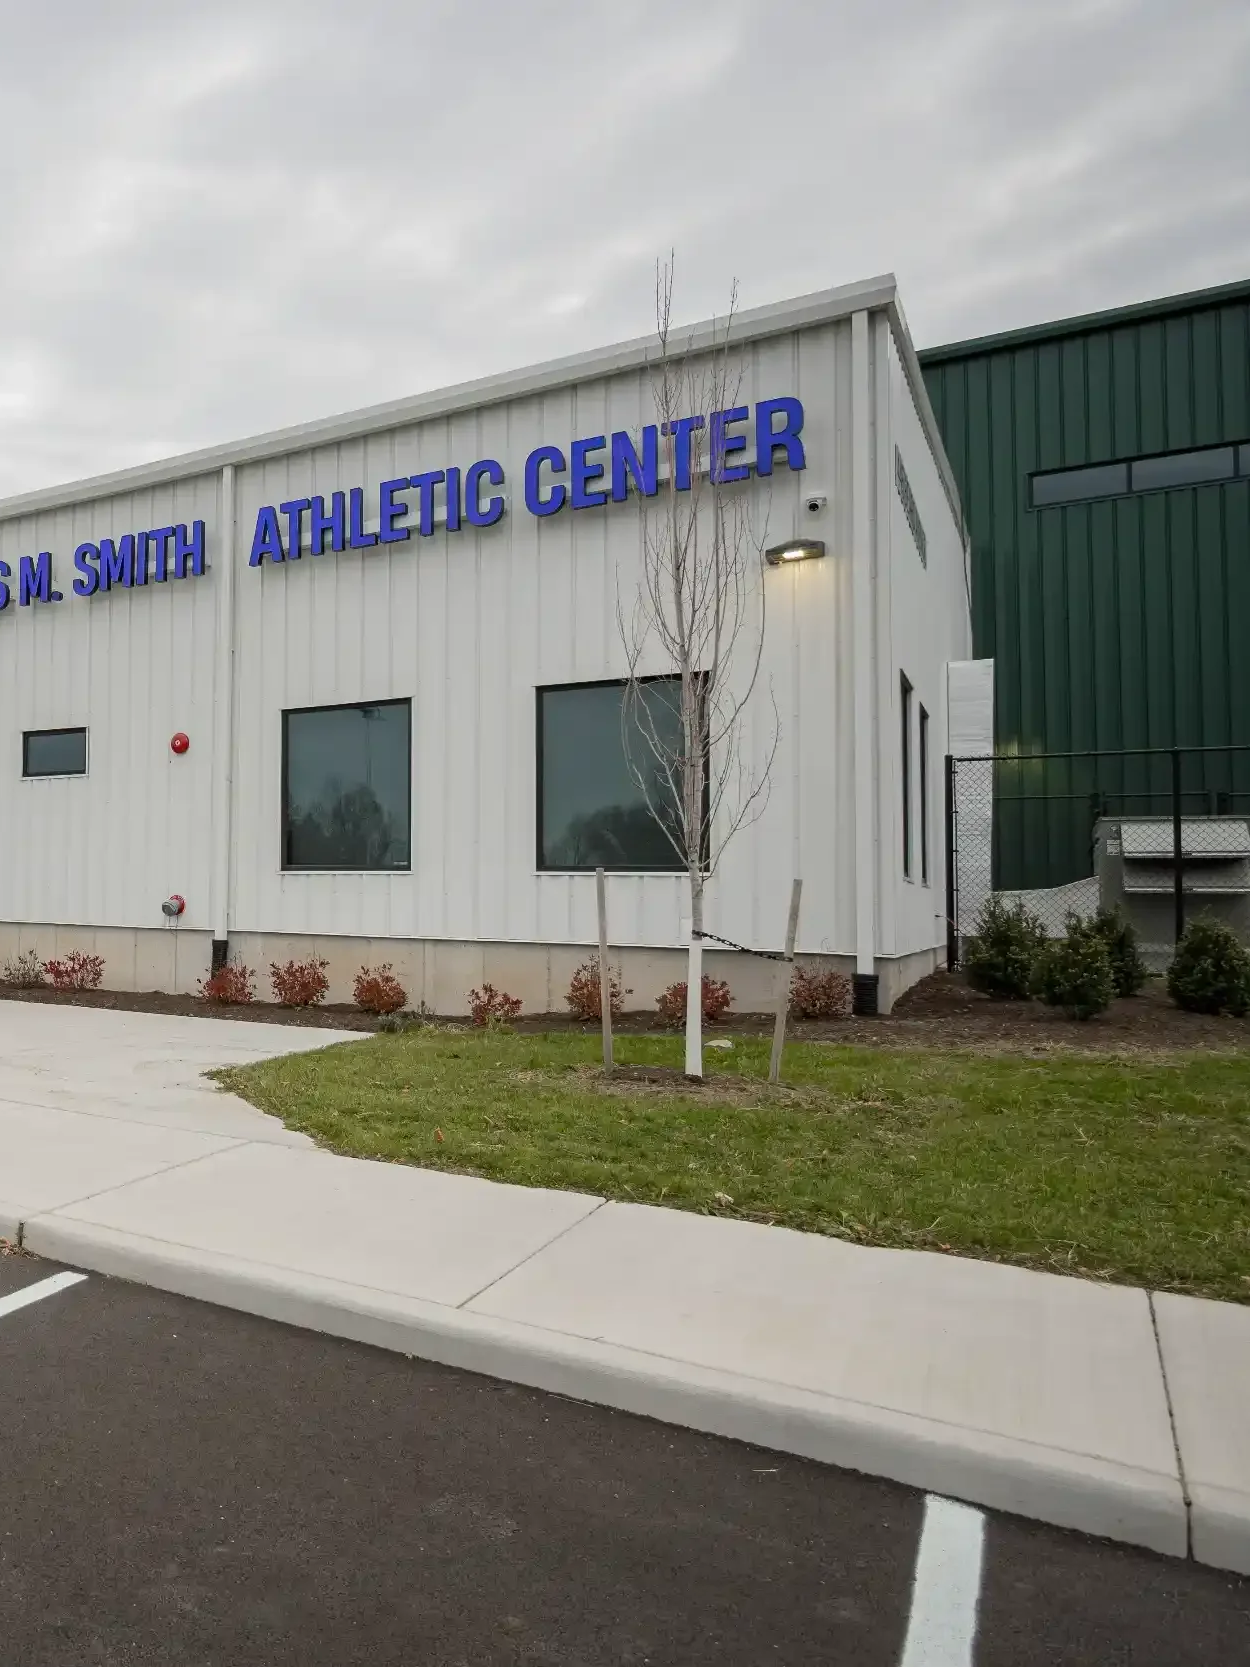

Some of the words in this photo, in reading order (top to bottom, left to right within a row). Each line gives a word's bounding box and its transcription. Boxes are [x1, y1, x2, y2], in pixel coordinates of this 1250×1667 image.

[19, 551, 63, 606] M.
[73, 520, 205, 597] SMITH
[250, 459, 503, 567] ATHLETIC
[523, 396, 806, 516] CENTER
